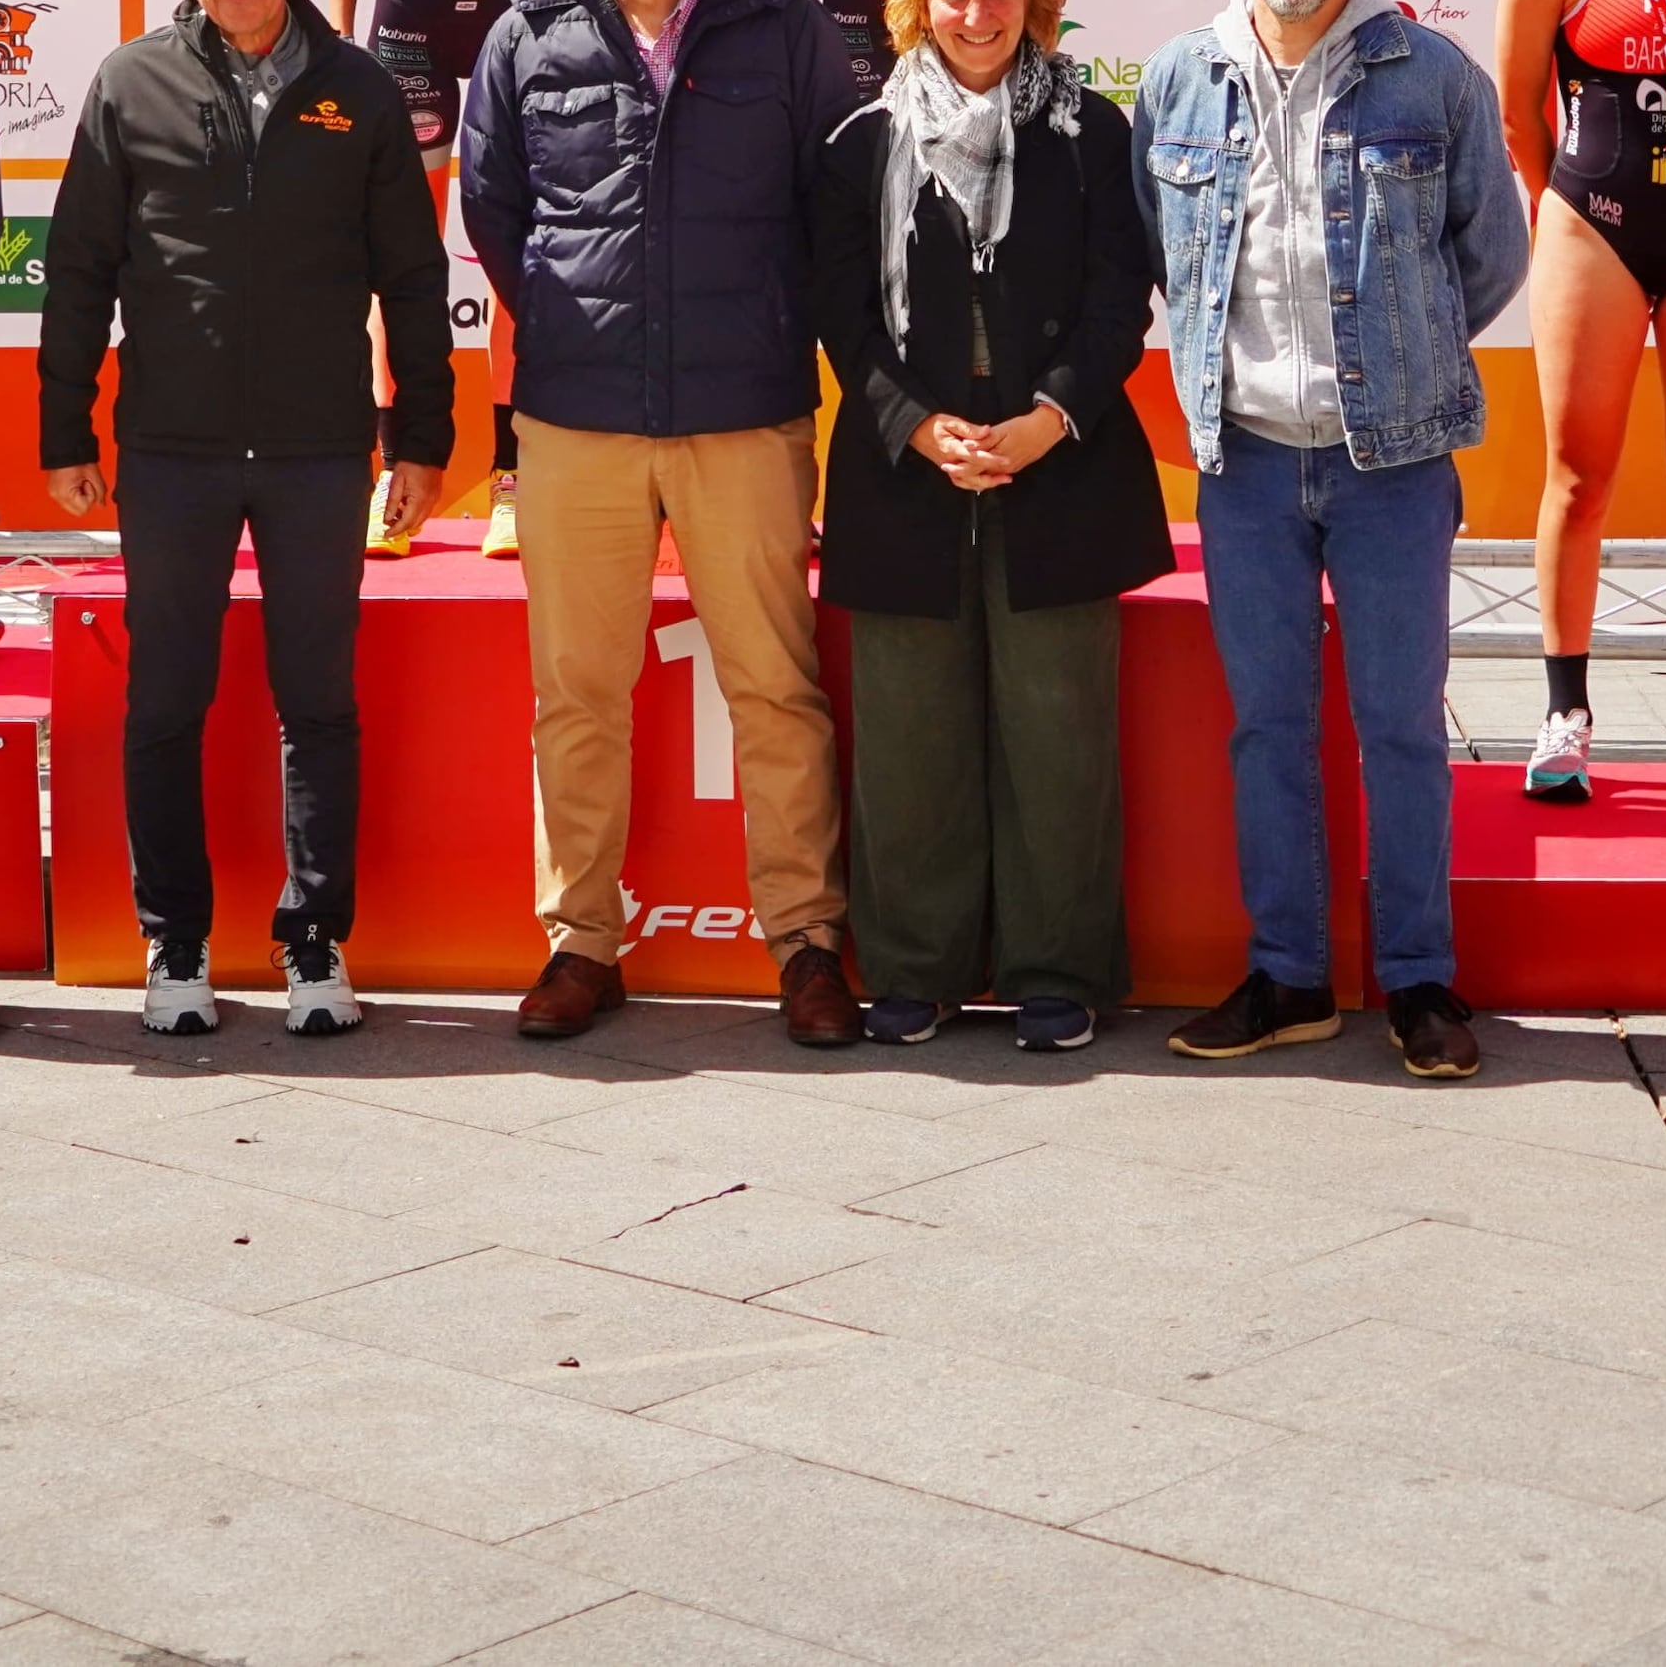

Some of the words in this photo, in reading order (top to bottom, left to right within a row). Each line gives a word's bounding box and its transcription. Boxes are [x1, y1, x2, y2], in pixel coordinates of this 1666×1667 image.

[377, 24, 428, 44] babaria
[1589, 191, 1623, 216] MAD
[1588, 207, 1622, 227] CHAIN
[8, 275, 23, 285] de
[653, 617, 735, 800] 1
